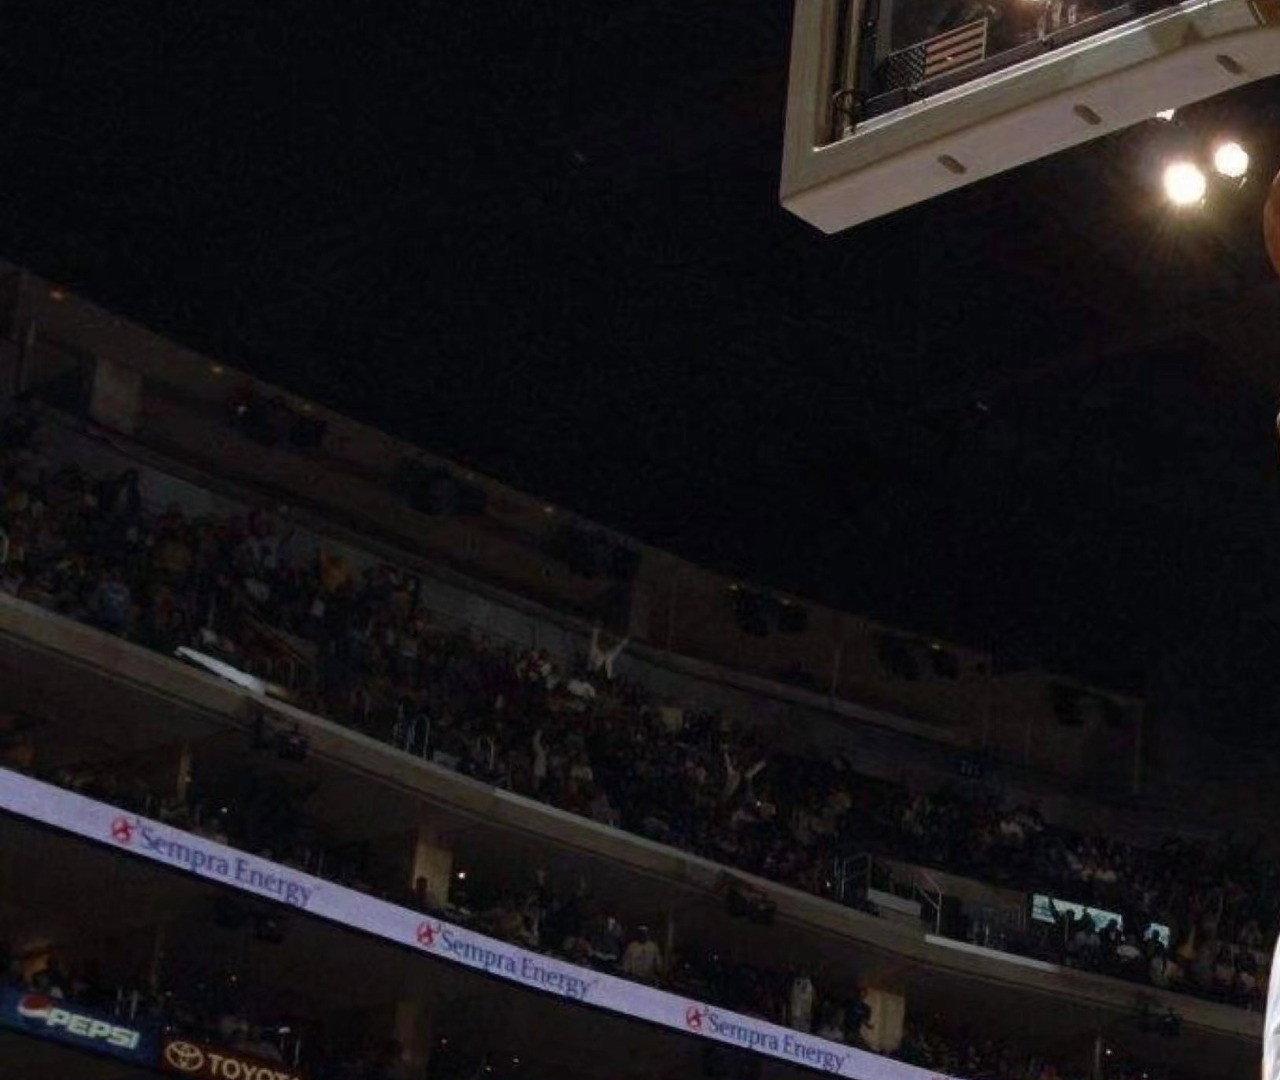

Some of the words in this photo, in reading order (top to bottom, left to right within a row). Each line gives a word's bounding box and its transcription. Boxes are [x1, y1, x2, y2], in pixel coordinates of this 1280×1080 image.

[141, 827, 228, 875] Sempra
[236, 857, 314, 907] Energy
[440, 931, 515, 975] Sempra
[521, 957, 588, 998] Energy
[47, 1008, 139, 1049] PEPSI
[707, 1011, 779, 1052] Sempra
[783, 1033, 844, 1072] Energy
